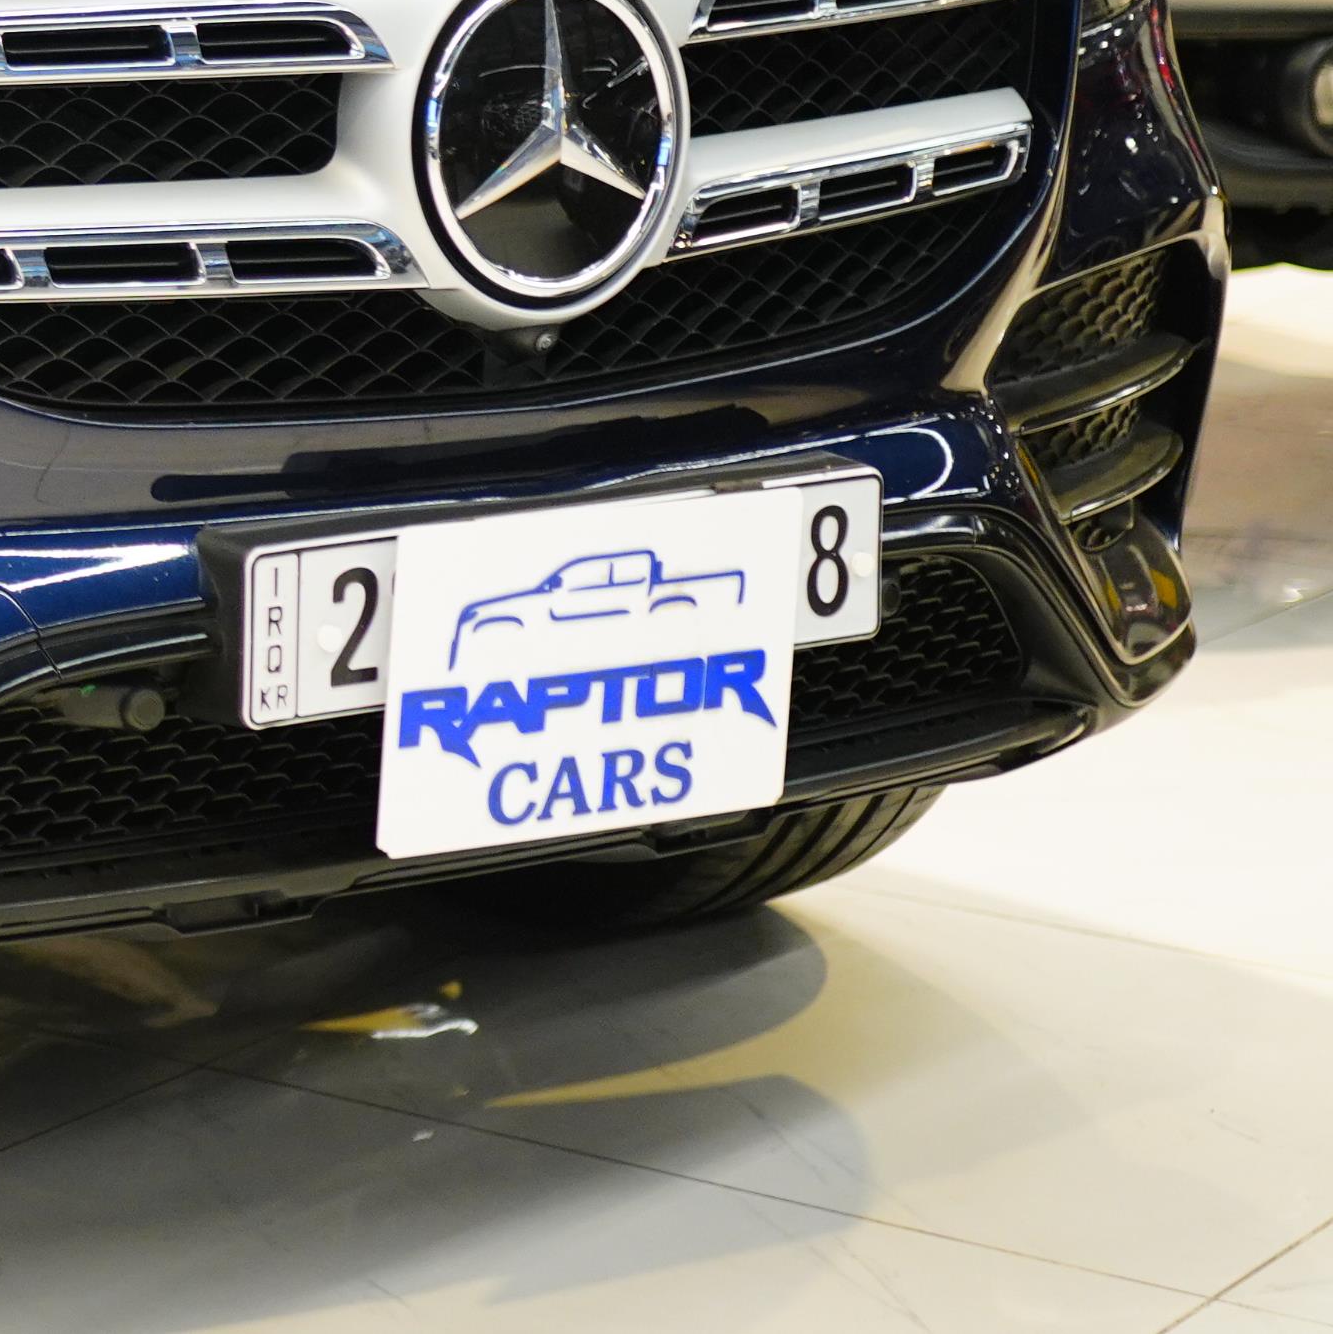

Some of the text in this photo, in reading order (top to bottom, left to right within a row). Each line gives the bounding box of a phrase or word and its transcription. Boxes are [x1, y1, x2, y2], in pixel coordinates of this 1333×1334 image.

[331, 504, 849, 688] 2 8
[399, 649, 777, 767] RAPTOR
[487, 741, 693, 825] CARS
